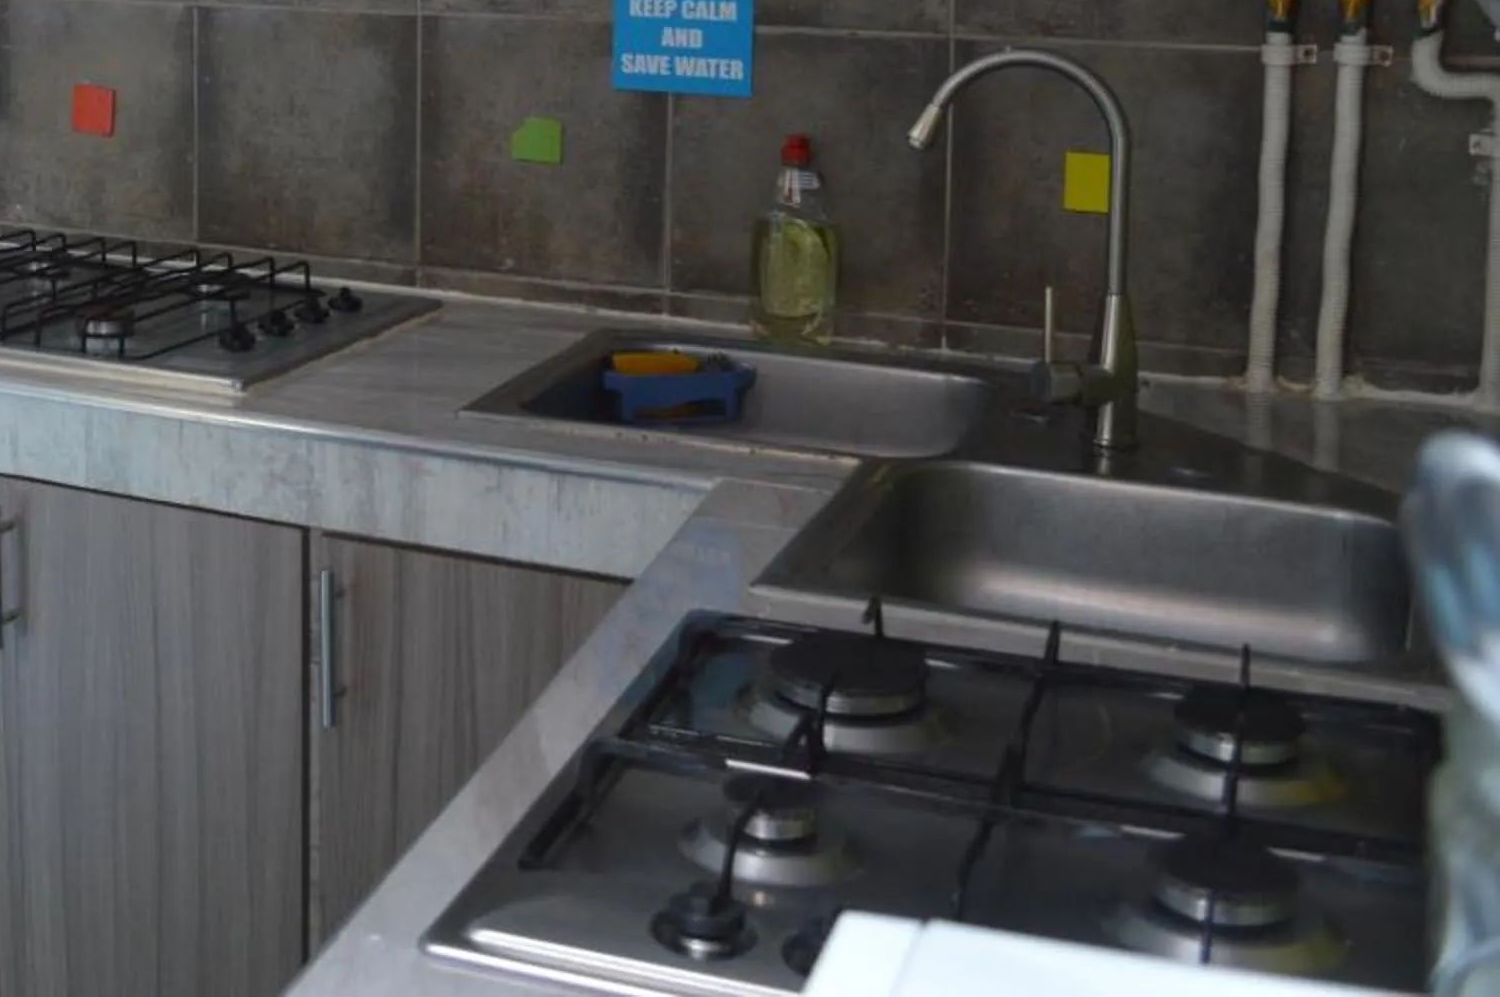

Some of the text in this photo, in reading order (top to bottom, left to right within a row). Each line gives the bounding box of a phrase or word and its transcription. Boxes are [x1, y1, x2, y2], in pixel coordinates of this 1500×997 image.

[681, 0, 737, 22] CALM
[661, 26, 703, 48] AND
[621, 53, 744, 80] SAVE WATER
